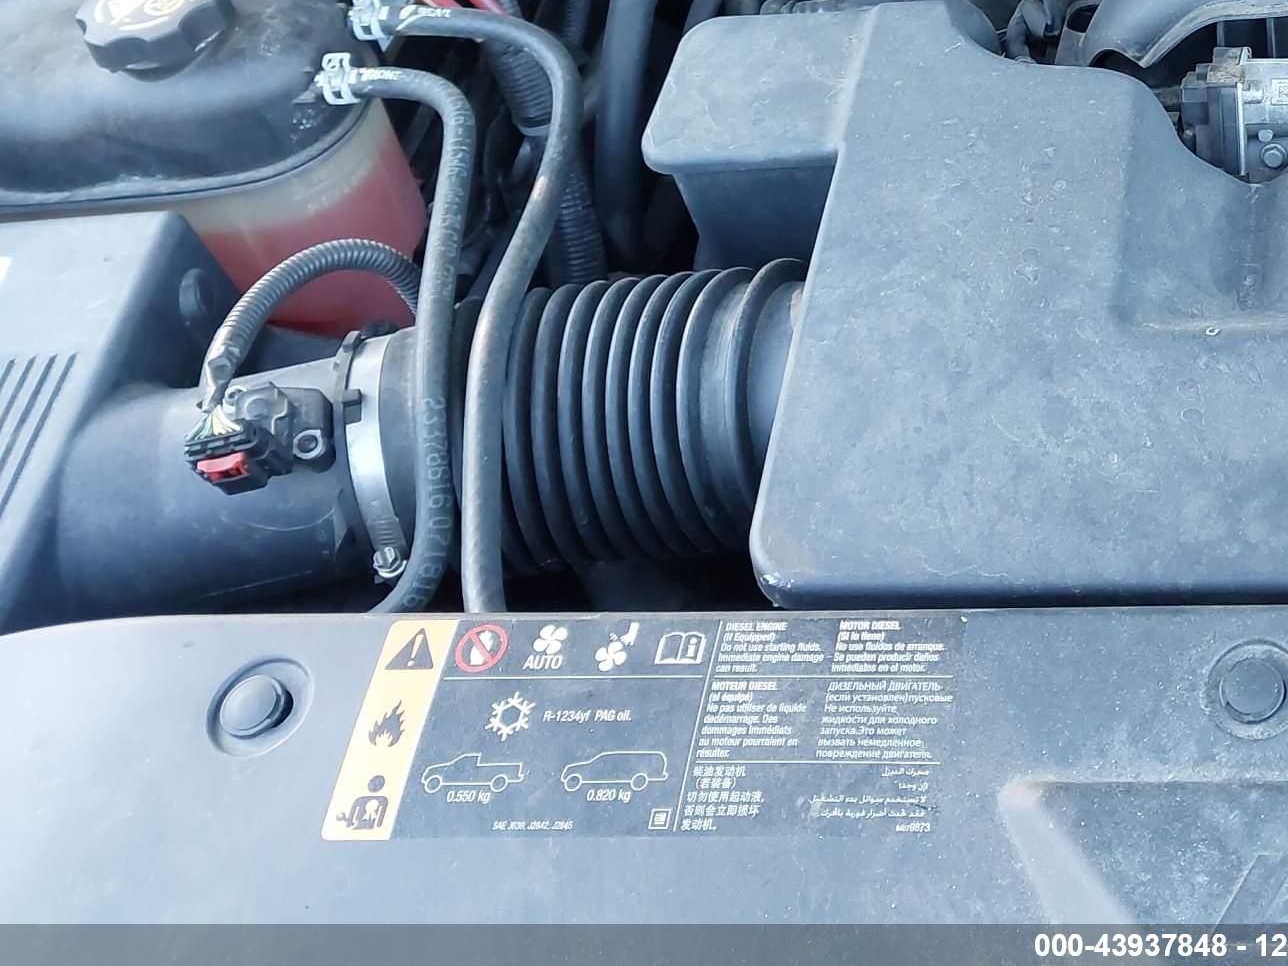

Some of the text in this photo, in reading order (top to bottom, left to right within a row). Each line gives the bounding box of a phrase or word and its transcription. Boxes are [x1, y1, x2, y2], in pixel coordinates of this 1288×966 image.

[725, 622, 788, 631] DIESEL ENGINE
[840, 621, 901, 630] MOTOR DIESEL
[734, 633, 776, 642] Equipped)
[860, 632, 884, 641] tiene)
[720, 643, 731, 651] Do
[733, 643, 747, 651] not
[764, 643, 796, 653] starting
[797, 642, 822, 651] fluids.
[835, 642, 944, 652] No use fluidos de arranque.
[522, 654, 563, 669] AUTO
[718, 653, 824, 663] Immediate engine damage
[833, 653, 939, 663] Se pueden producir daños
[732, 664, 758, 672] result.
[831, 663, 876, 672] inmediatos
[890, 663, 898, 672] el
[900, 663, 926, 672] motor.
[711, 681, 778, 690] MOTEUR DIESEL
[827, 681, 886, 692] ДИЗЕЛЬНЫЙ
[825, 693, 850, 703] (если
[706, 703, 807, 714] Ne pas utiliser de liquide
[824, 704, 837, 713] Не
[543, 709, 632, 723] R-1234yf PAG oil.
[762, 714, 778, 723] Des
[821, 716, 937, 725] жидкости для холодного
[701, 725, 792, 736] dommages immédiats
[876, 727, 907, 736] может
[698, 737, 798, 747] au moteur pourraient en
[817, 739, 855, 747] вызвать
[815, 749, 881, 759] повреждение
[693, 765, 746, 777] 柴油发动机
[446, 790, 491, 804] 0.550 kg
[586, 789, 632, 803] 0.820 kg
[684, 804, 761, 819] 否则会立即损坏
[492, 821, 506, 830] SAE
